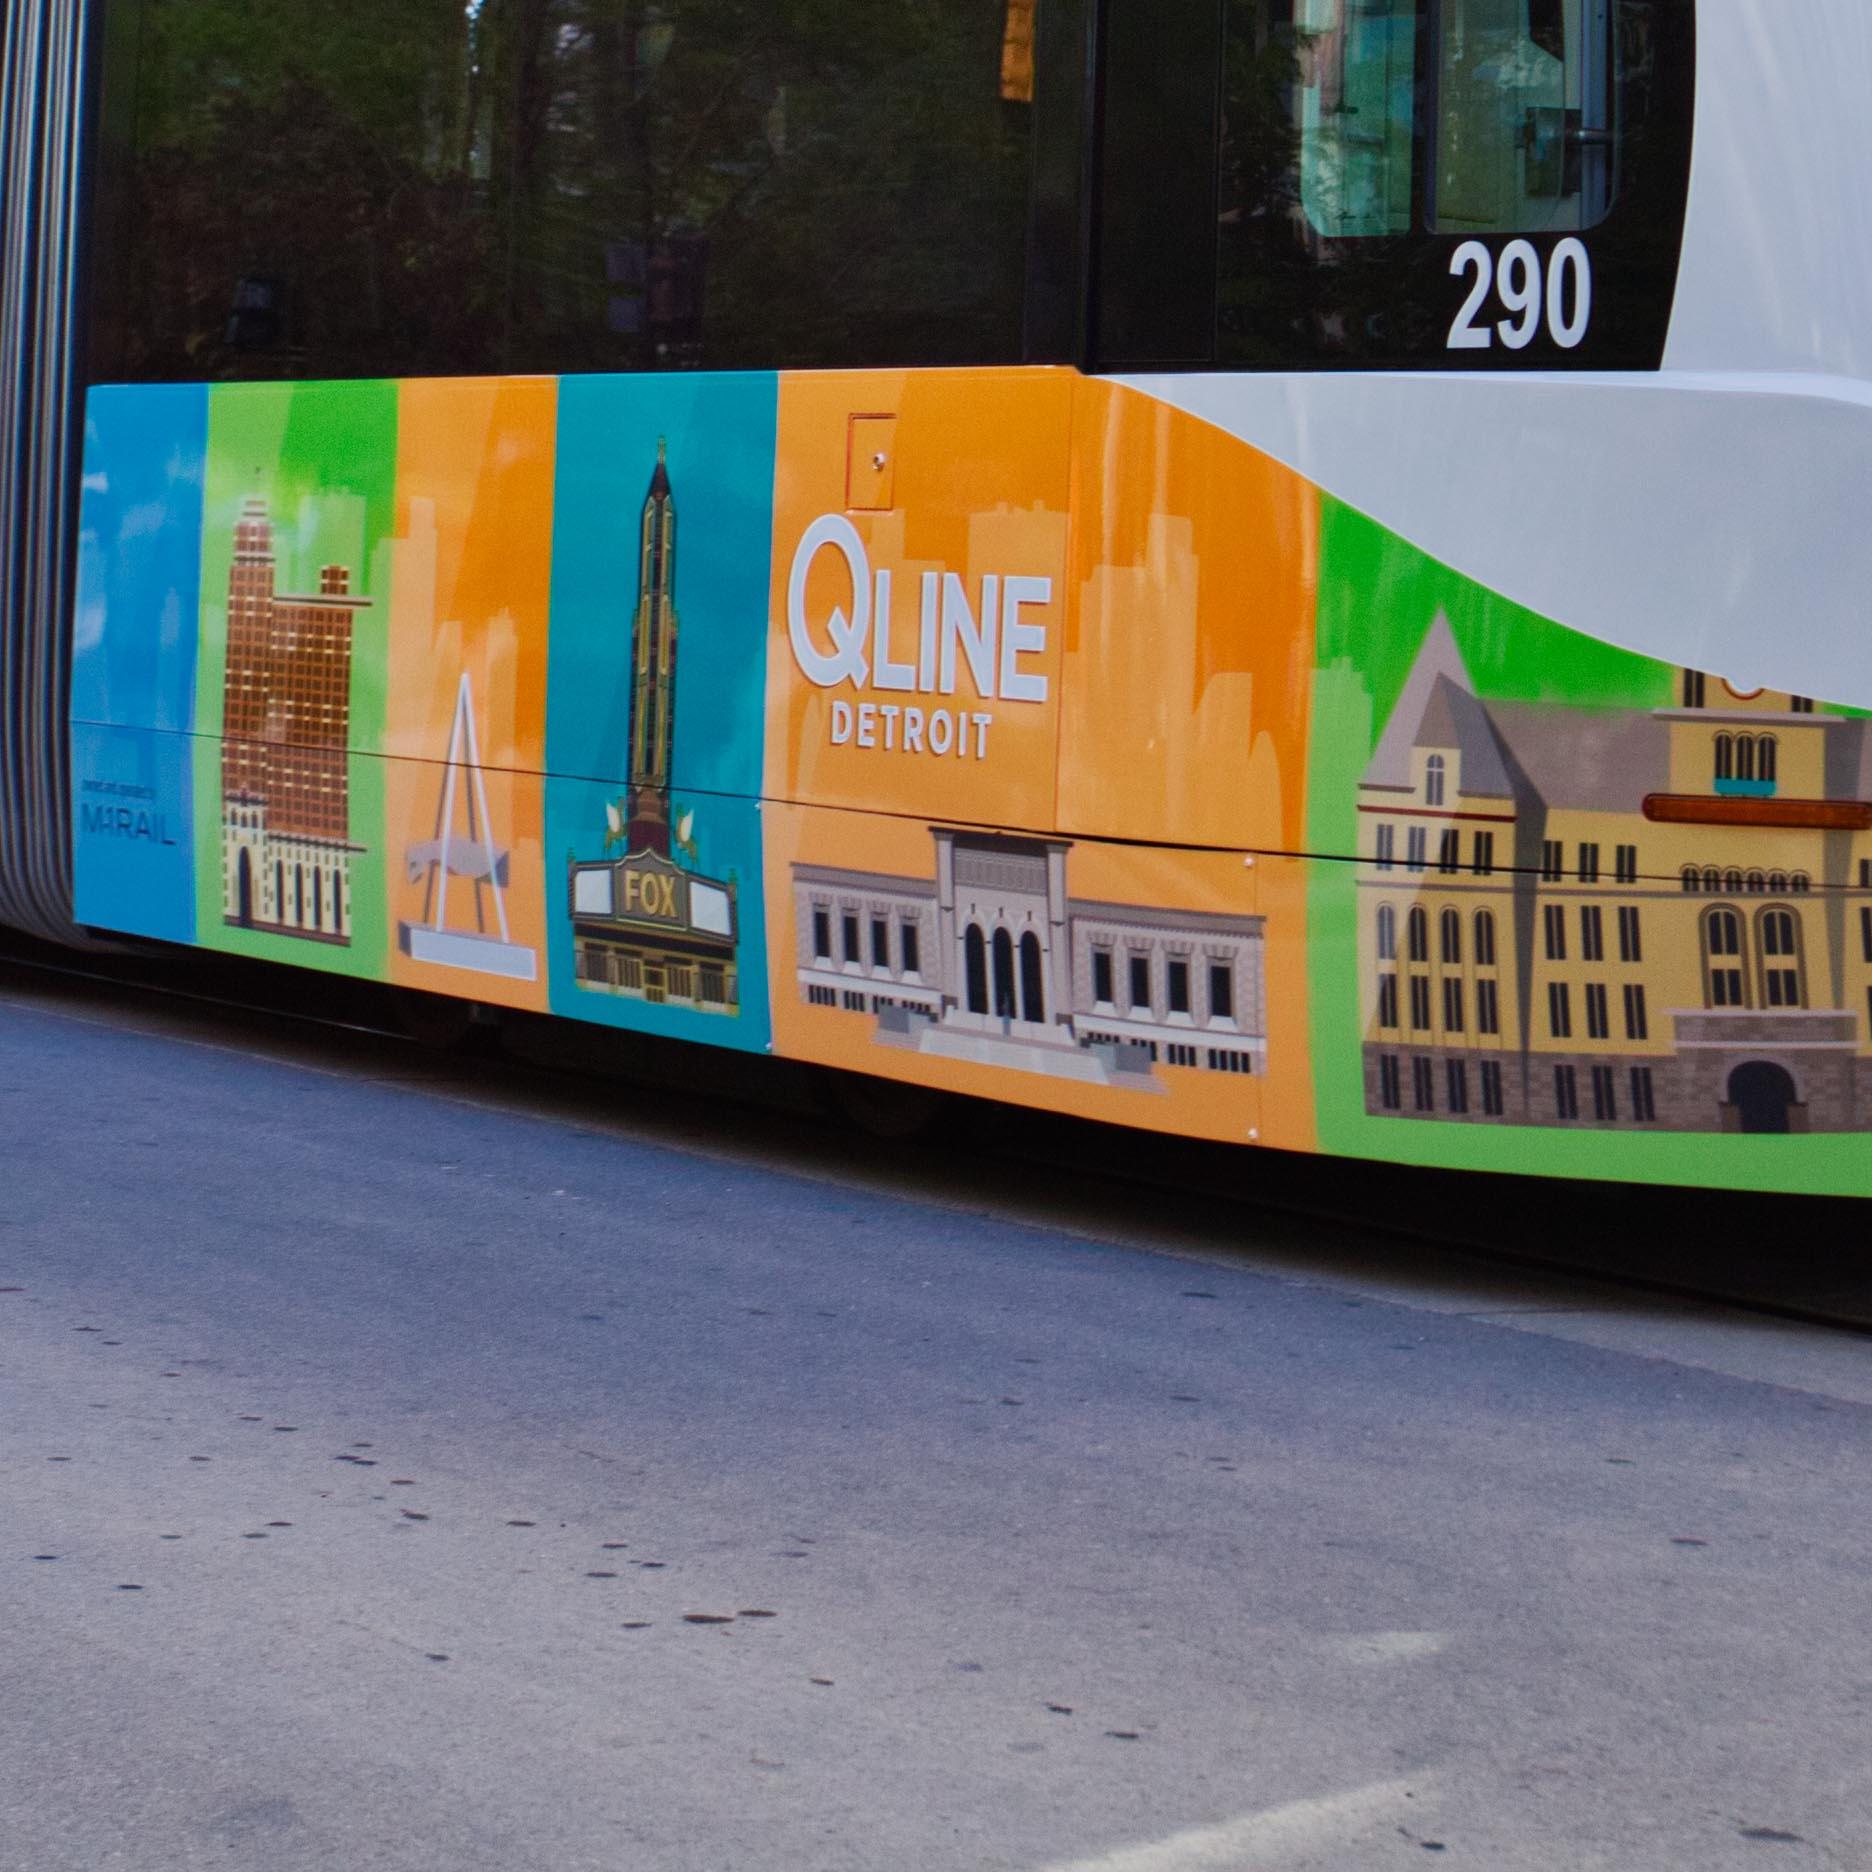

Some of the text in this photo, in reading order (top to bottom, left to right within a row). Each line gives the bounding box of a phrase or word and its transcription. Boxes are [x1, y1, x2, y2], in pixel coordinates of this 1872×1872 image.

[1446, 236, 1591, 350] 290
[788, 513, 1052, 703] QLINE
[831, 700, 992, 760] DETROIT
[624, 869, 677, 918] FOX
